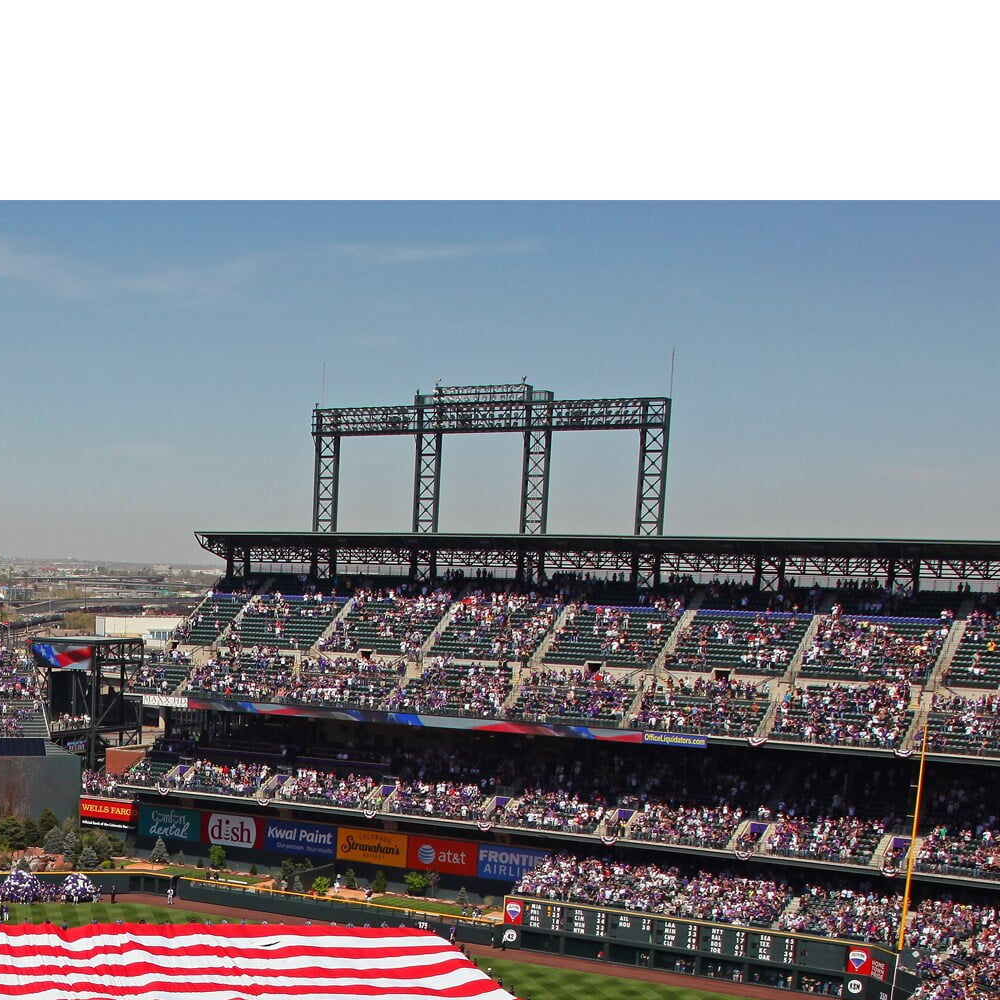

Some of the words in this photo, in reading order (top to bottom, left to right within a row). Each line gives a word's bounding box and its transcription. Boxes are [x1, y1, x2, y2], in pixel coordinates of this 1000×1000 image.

[644, 733, 706, 746] OfficeLiquidators.com
[81, 803, 110, 814] WELLS
[110, 806, 138, 817] FARGO
[149, 822, 191, 839] dental
[210, 818, 253, 844] dish
[267, 826, 297, 842] Kwal
[299, 829, 333, 845] Paint
[340, 835, 400, 856] Stranahan's
[438, 849, 466, 865] at&t
[664, 921, 676, 929] LAA
[710, 940, 722, 948] BOS
[759, 940, 770, 948] TEX
[758, 953, 771, 961] OAK
[871, 959, 886, 970] HOME
